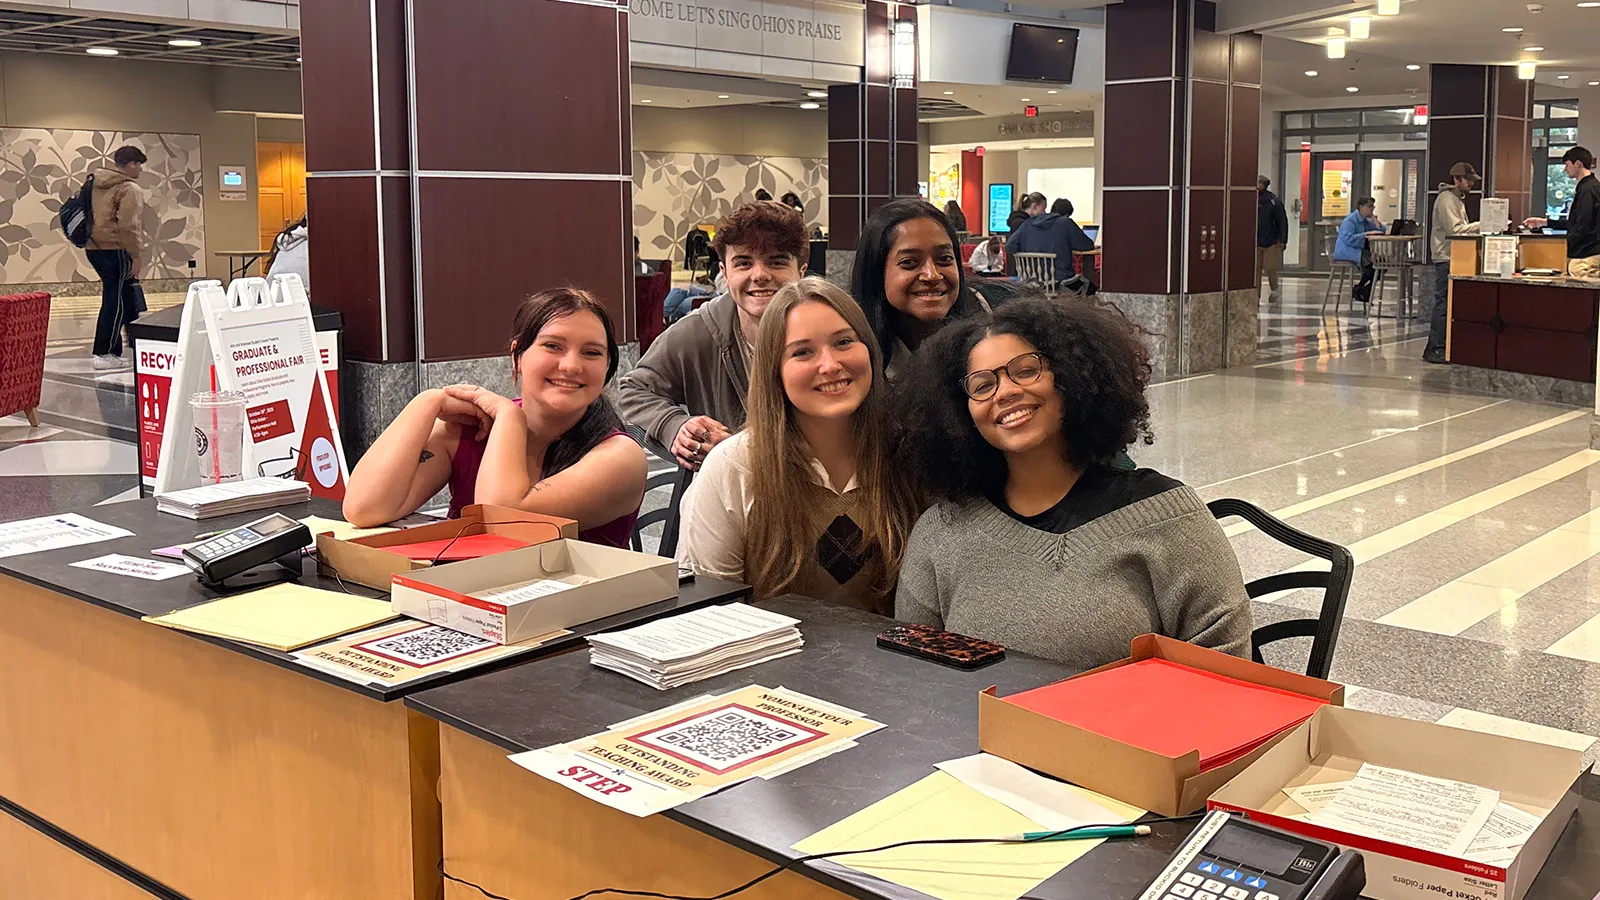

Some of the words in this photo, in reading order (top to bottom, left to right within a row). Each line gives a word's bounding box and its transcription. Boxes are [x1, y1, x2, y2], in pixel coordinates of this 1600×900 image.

[630, 0, 674, 20] COME
[678, 7, 715, 24] LET'S
[718, 12, 750, 30] SING
[752, 15, 795, 35] OHIO'S
[798, 20, 842, 40] PRAISE
[141, 351, 176, 370] RECY
[232, 345, 272, 361] GRADUATE
[273, 344, 279, 354] &
[236, 359, 289, 377] PROFESSIONAL
[288, 355, 304, 366] FAIR
[756, 703, 824, 727] PROFESSOR
[757, 693, 820, 715] NOMINATE
[818, 712, 853, 726] YOUR
[587, 745, 647, 772] TEACHING
[644, 767, 692, 788] AWARD
[615, 743, 700, 779] OUTSTANDING
[557, 765, 632, 796] STEP
[1209, 813, 1225, 831] MUST
[1186, 831, 1209, 855] RETURN
[1177, 856, 1187, 866] TO
[1464, 863, 1489, 875] Folders
[1155, 866, 1178, 890] BUCKID
[1463, 876, 1478, 884] Size
[1490, 868, 1498, 877] 25
[1392, 875, 1424, 890] Folders
[1426, 883, 1453, 898] Paper
[1482, 880, 1498, 890] Letter
[1455, 890, 1487, 900] ocket
[1484, 890, 1498, 898] Red
